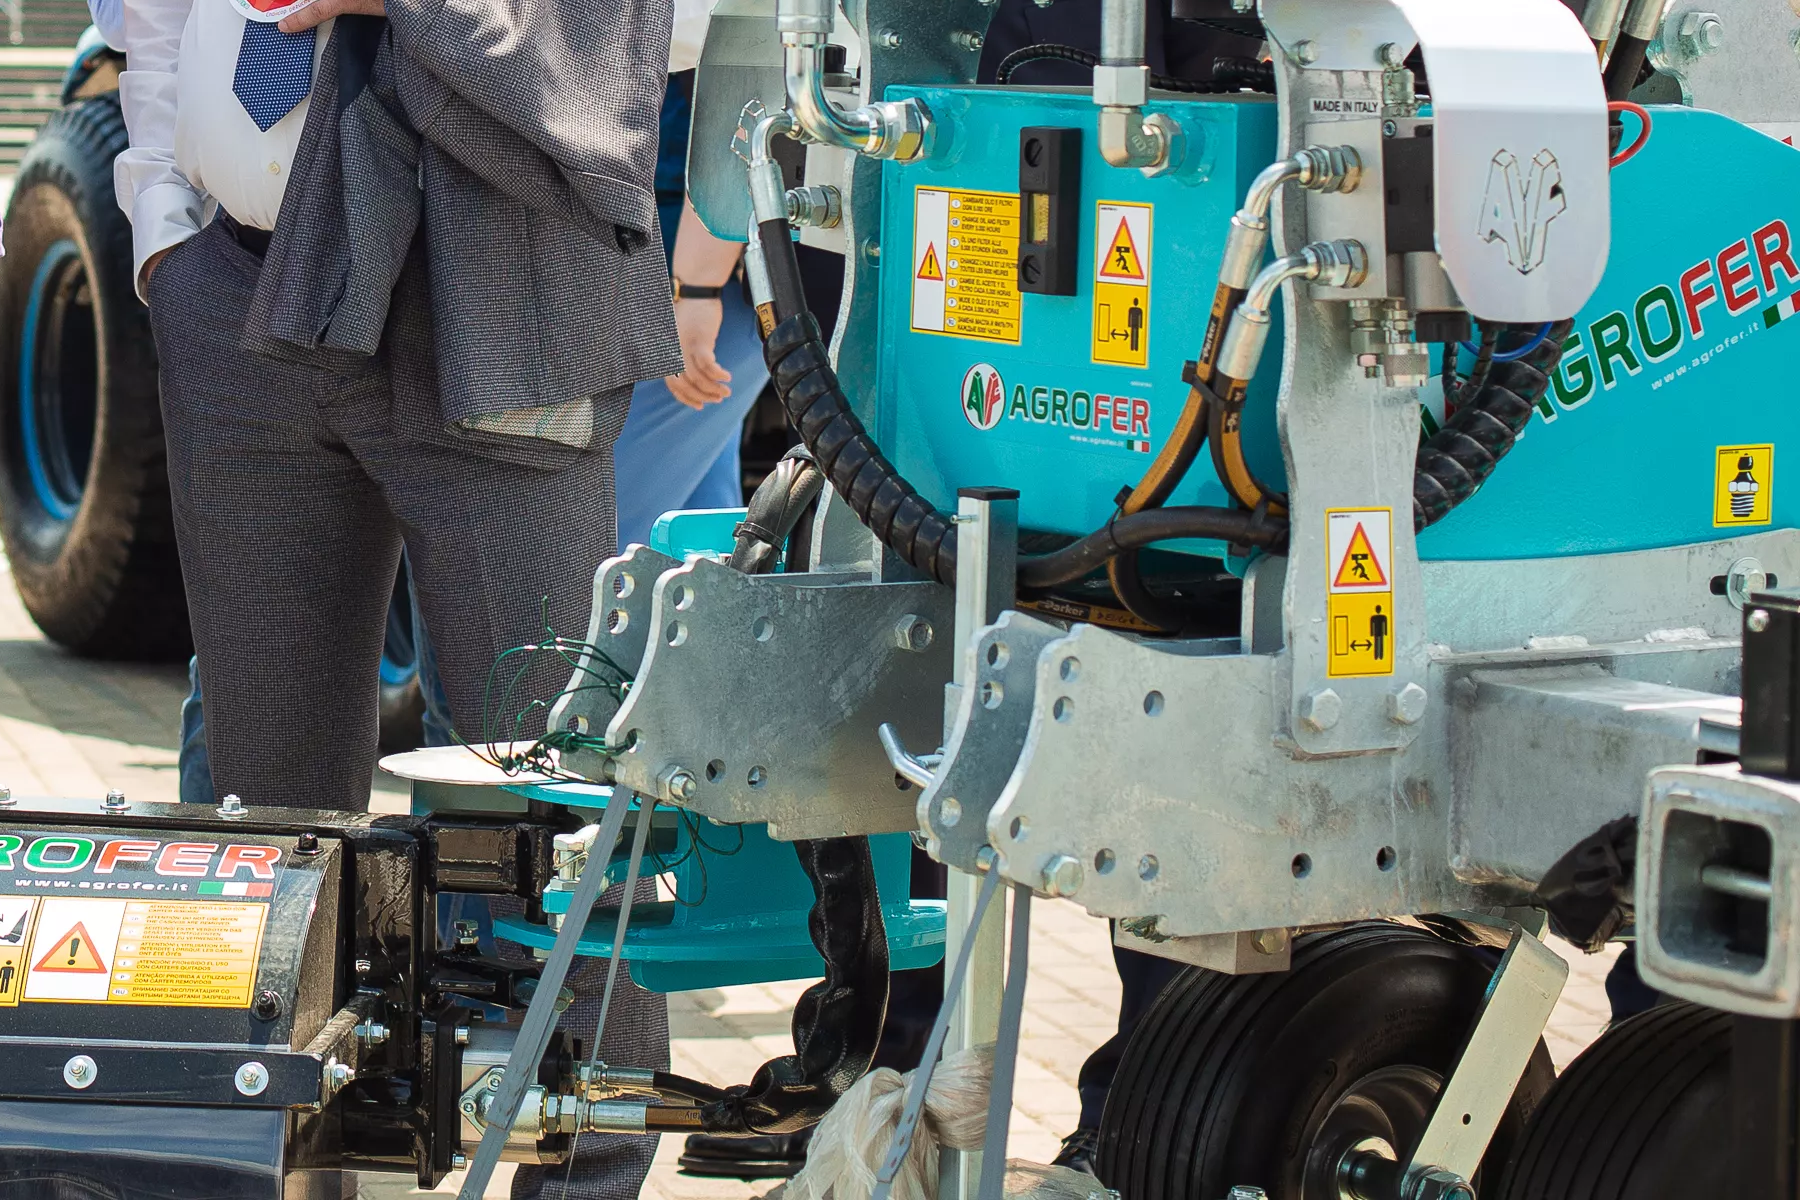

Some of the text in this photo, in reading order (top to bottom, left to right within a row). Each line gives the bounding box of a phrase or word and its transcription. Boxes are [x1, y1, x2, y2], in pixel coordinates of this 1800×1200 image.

[1313, 100, 1378, 113] MADE IN ITALY
[1201, 320, 1218, 363] Parker
[1515, 218, 1800, 442] GROFER
[1650, 321, 1761, 390] www.agrofer.it
[1007, 383, 1152, 438] AGROFER
[1043, 600, 1085, 617] Parker
[13, 877, 190, 893] www.agrofer.it
